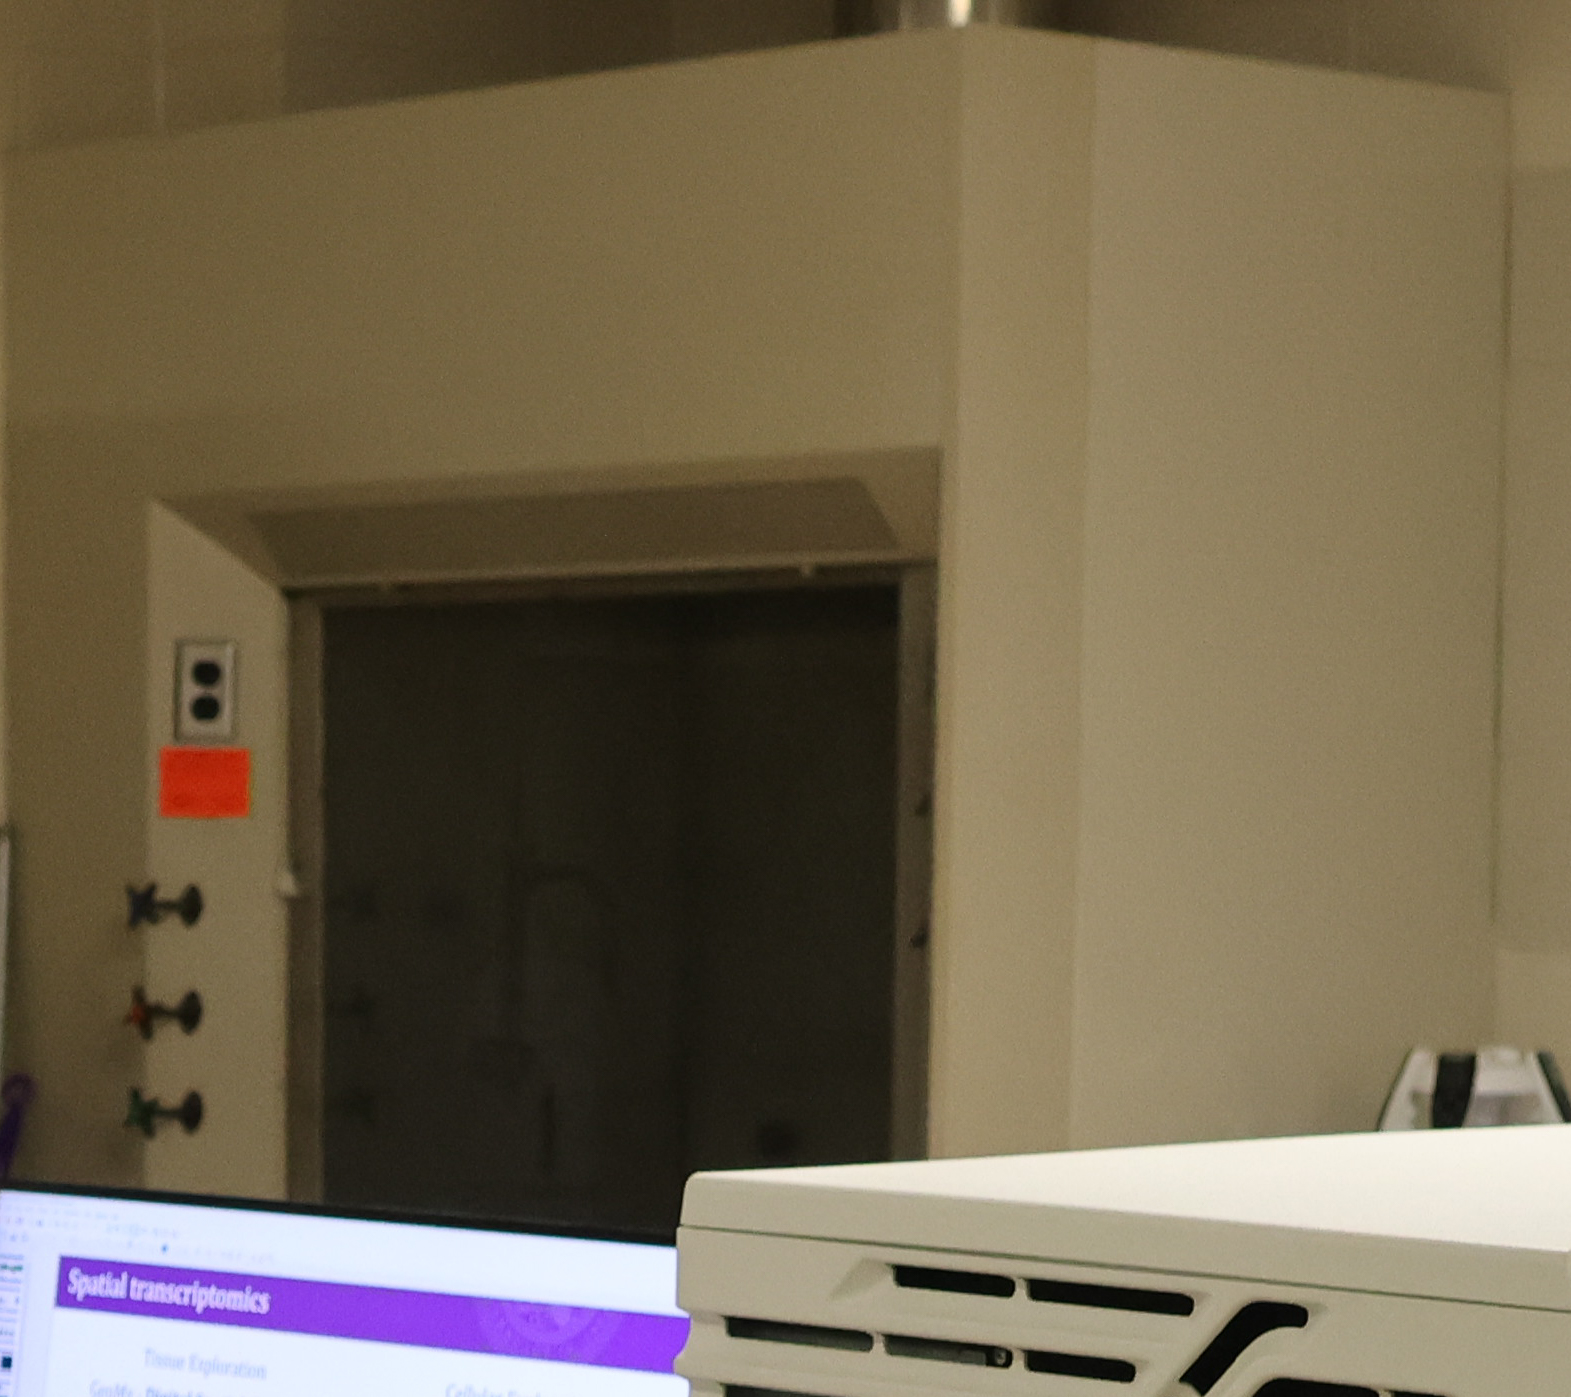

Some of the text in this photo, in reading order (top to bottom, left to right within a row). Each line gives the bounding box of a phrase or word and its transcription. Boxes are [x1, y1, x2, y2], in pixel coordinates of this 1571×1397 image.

[66, 1266, 272, 1315] Spatial transcriptomics
[144, 1349, 268, 1380] Tissue Exploration
